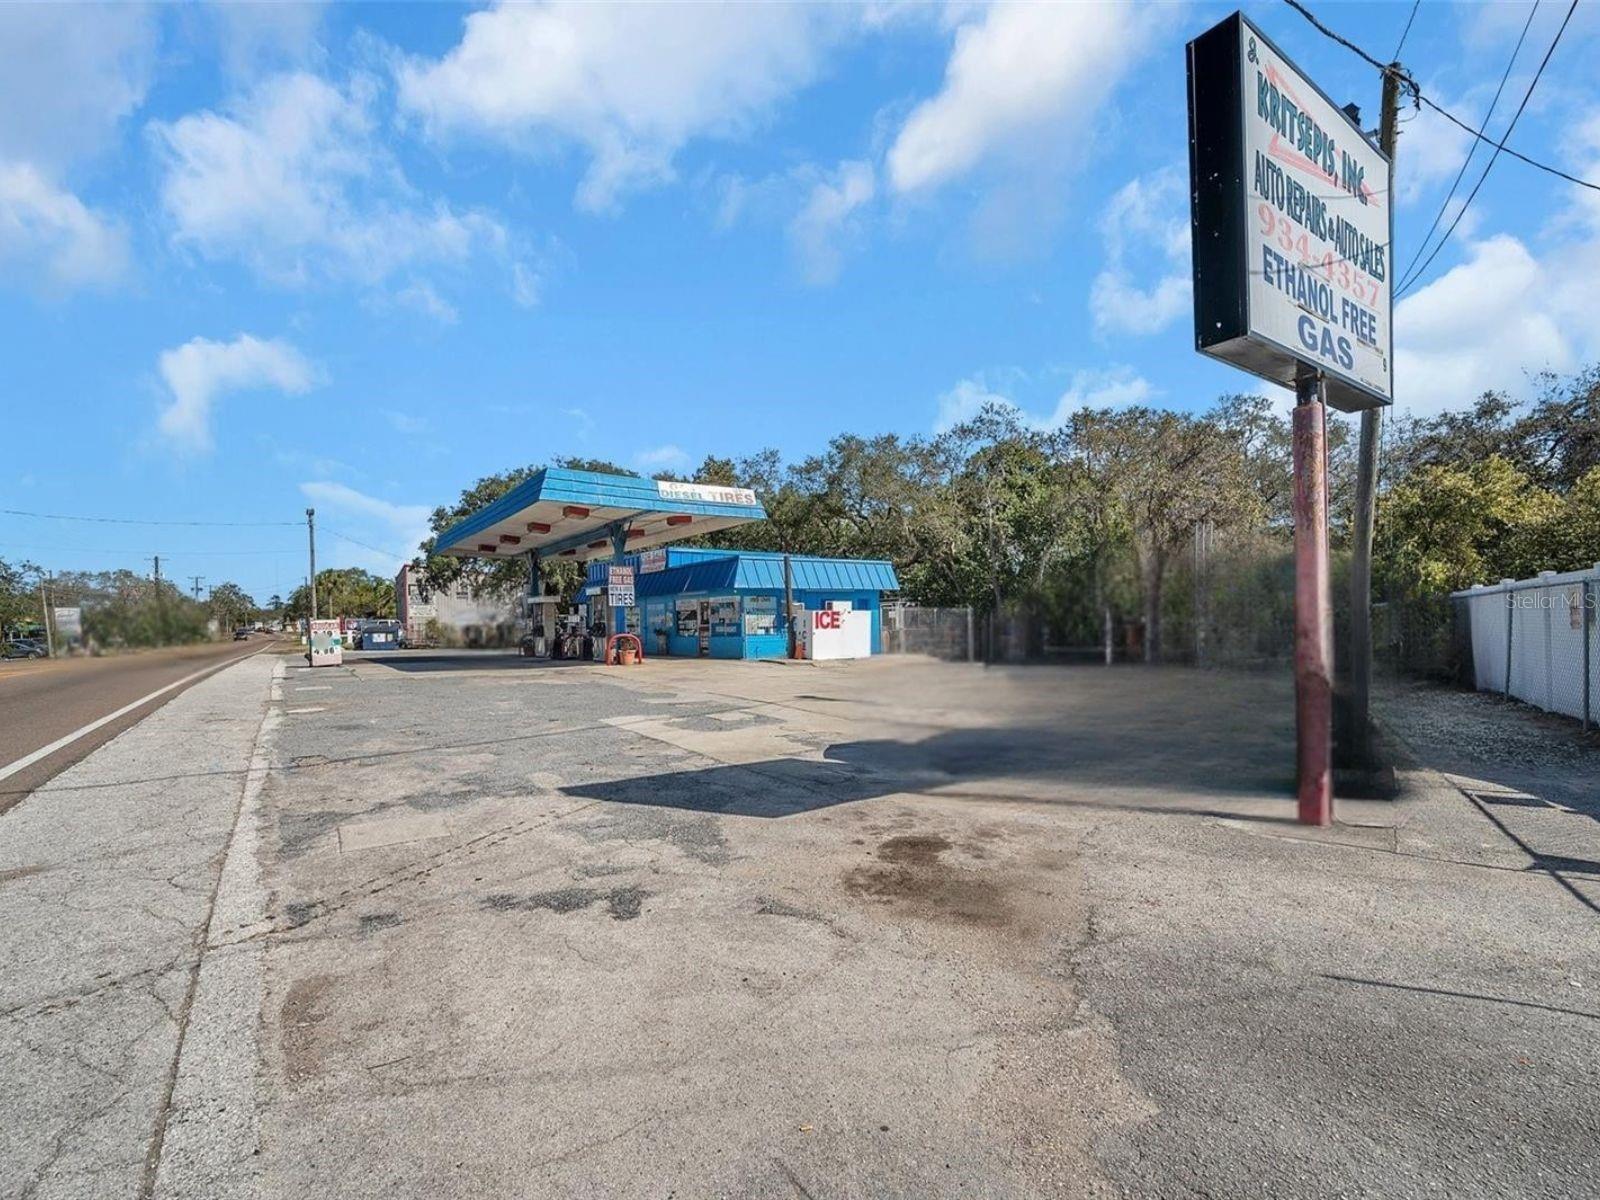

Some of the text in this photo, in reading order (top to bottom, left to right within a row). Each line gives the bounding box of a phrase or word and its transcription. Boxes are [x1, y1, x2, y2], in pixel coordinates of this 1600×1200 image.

[1257, 70, 1338, 188] KRITSEPIS,
[1254, 149, 1385, 283] AUTO REPAIRS & AUTO SALES
[1258, 203, 1380, 308] 934-4357
[1262, 243, 1377, 346] ETHANOL FREE
[1297, 314, 1354, 370] GAS
[660, 489, 755, 505] DIESEL TIRES
[609, 593, 634, 606] TIRES
[815, 611, 841, 630] ICE
